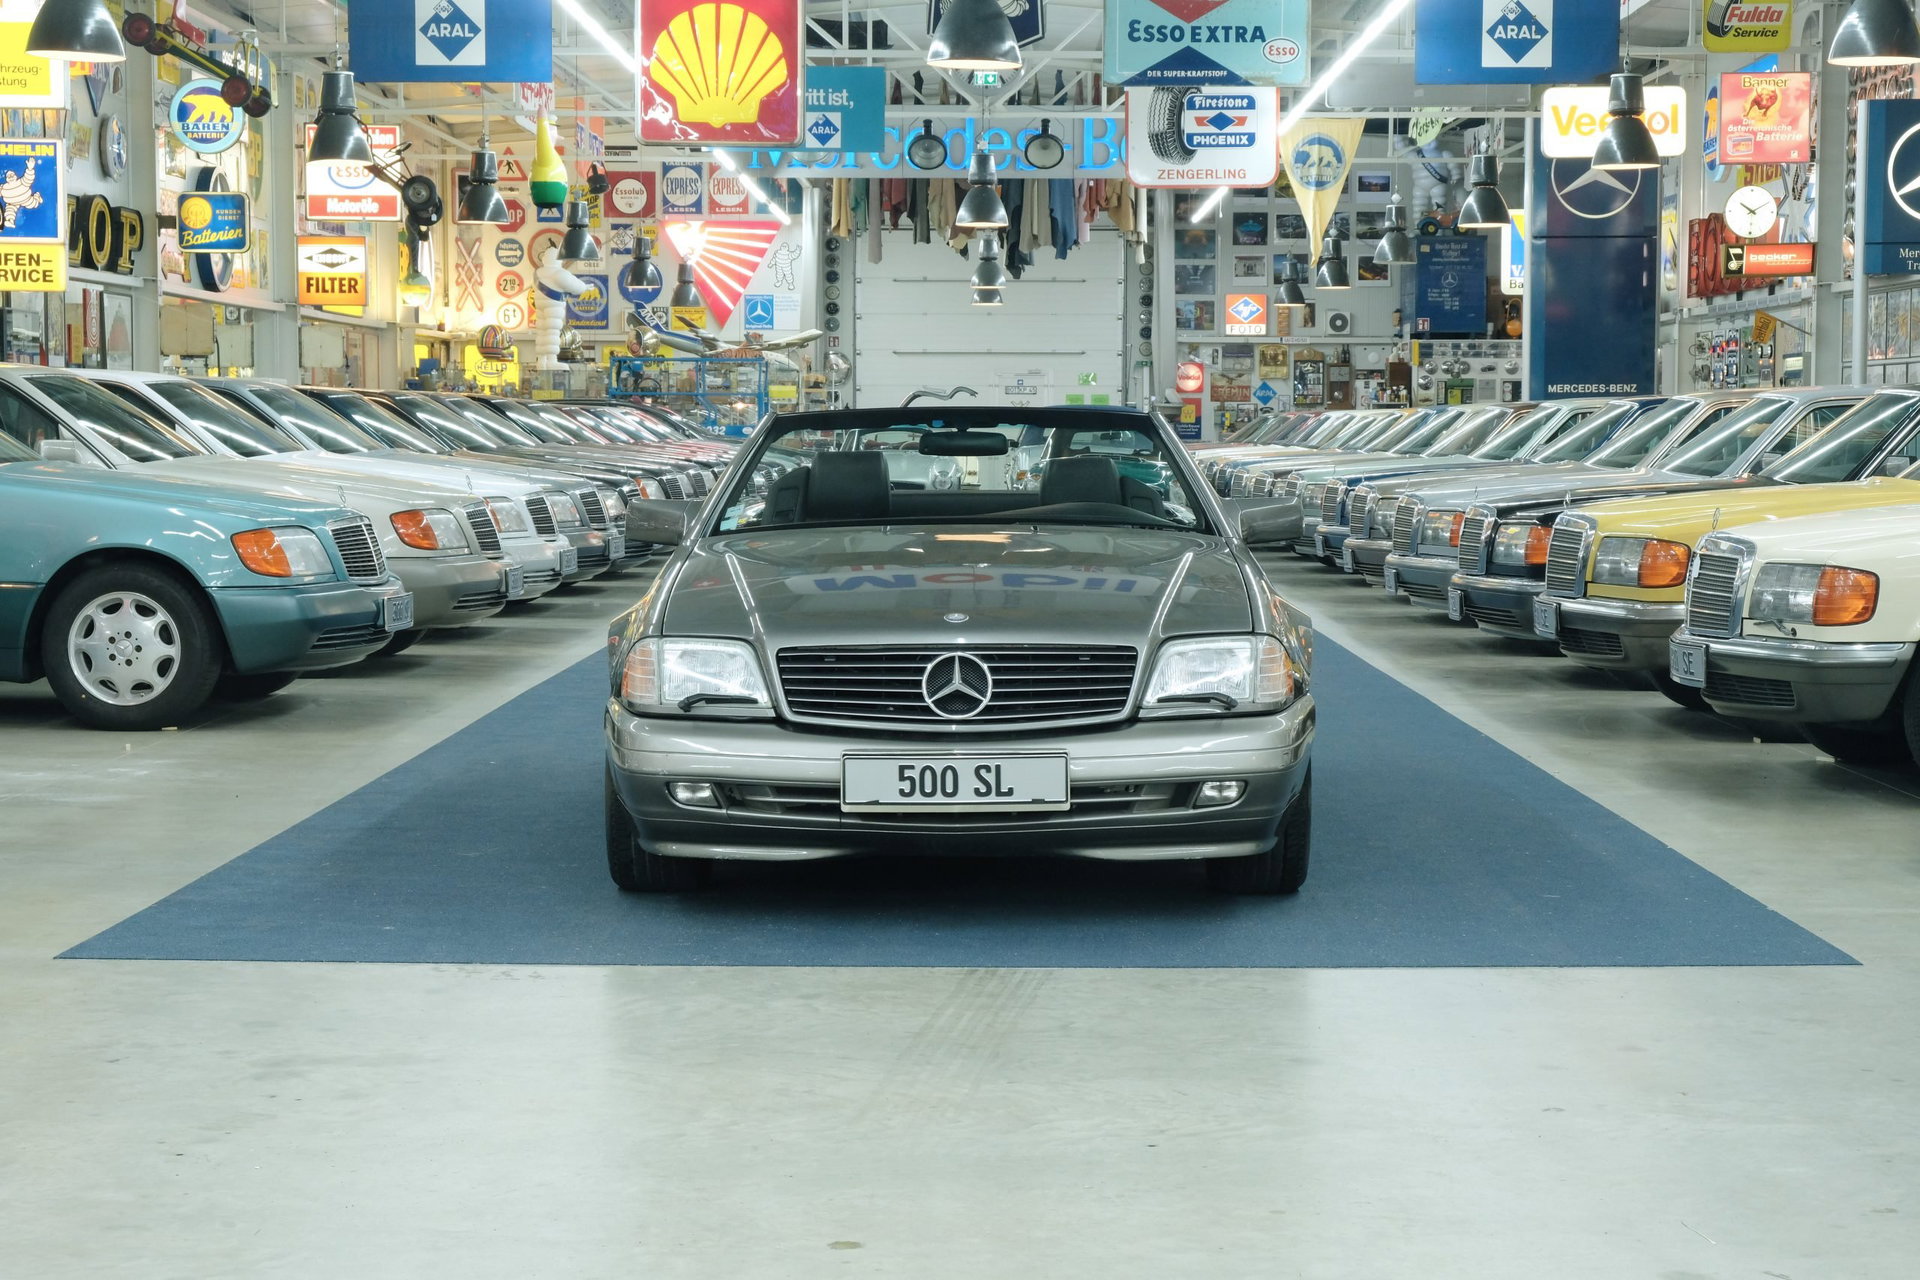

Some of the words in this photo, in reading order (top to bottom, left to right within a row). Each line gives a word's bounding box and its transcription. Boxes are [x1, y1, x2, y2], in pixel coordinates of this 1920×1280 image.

[1727, 6, 1783, 22] Fulda
[427, 23, 474, 37] ARAL
[1191, 25, 1266, 43] EXTRA
[1494, 25, 1542, 39] ARAL
[1733, 27, 1778, 37] Service
[1147, 70, 1162, 78] DER
[1163, 70, 1228, 78] SUPER-KRAFTSTOFF
[1742, 76, 1788, 88] Banner
[828, 89, 854, 108] ist,
[1193, 95, 1249, 109] Firestone
[1551, 104, 1678, 137] Veeol
[811, 126, 837, 135] ARAL
[1756, 131, 1804, 142] Batterie
[1193, 134, 1249, 146] PHOENIX
[1157, 169, 1247, 180] ZENGERLING
[665, 177, 699, 195] EXPRESS
[712, 177, 747, 196] EXPRESS
[326, 197, 379, 213] Motoröle
[181, 226, 243, 246] Batterien
[1750, 253, 1798, 261] becker
[306, 277, 359, 294] FILTER
[1230, 325, 1262, 334] FOTO
[477, 361, 508, 373] HELLA
[1547, 383, 1638, 393] MERCEDES-BENZ
[1682, 650, 1695, 676] SE
[898, 763, 960, 798] 500
[972, 763, 1015, 798] SL
